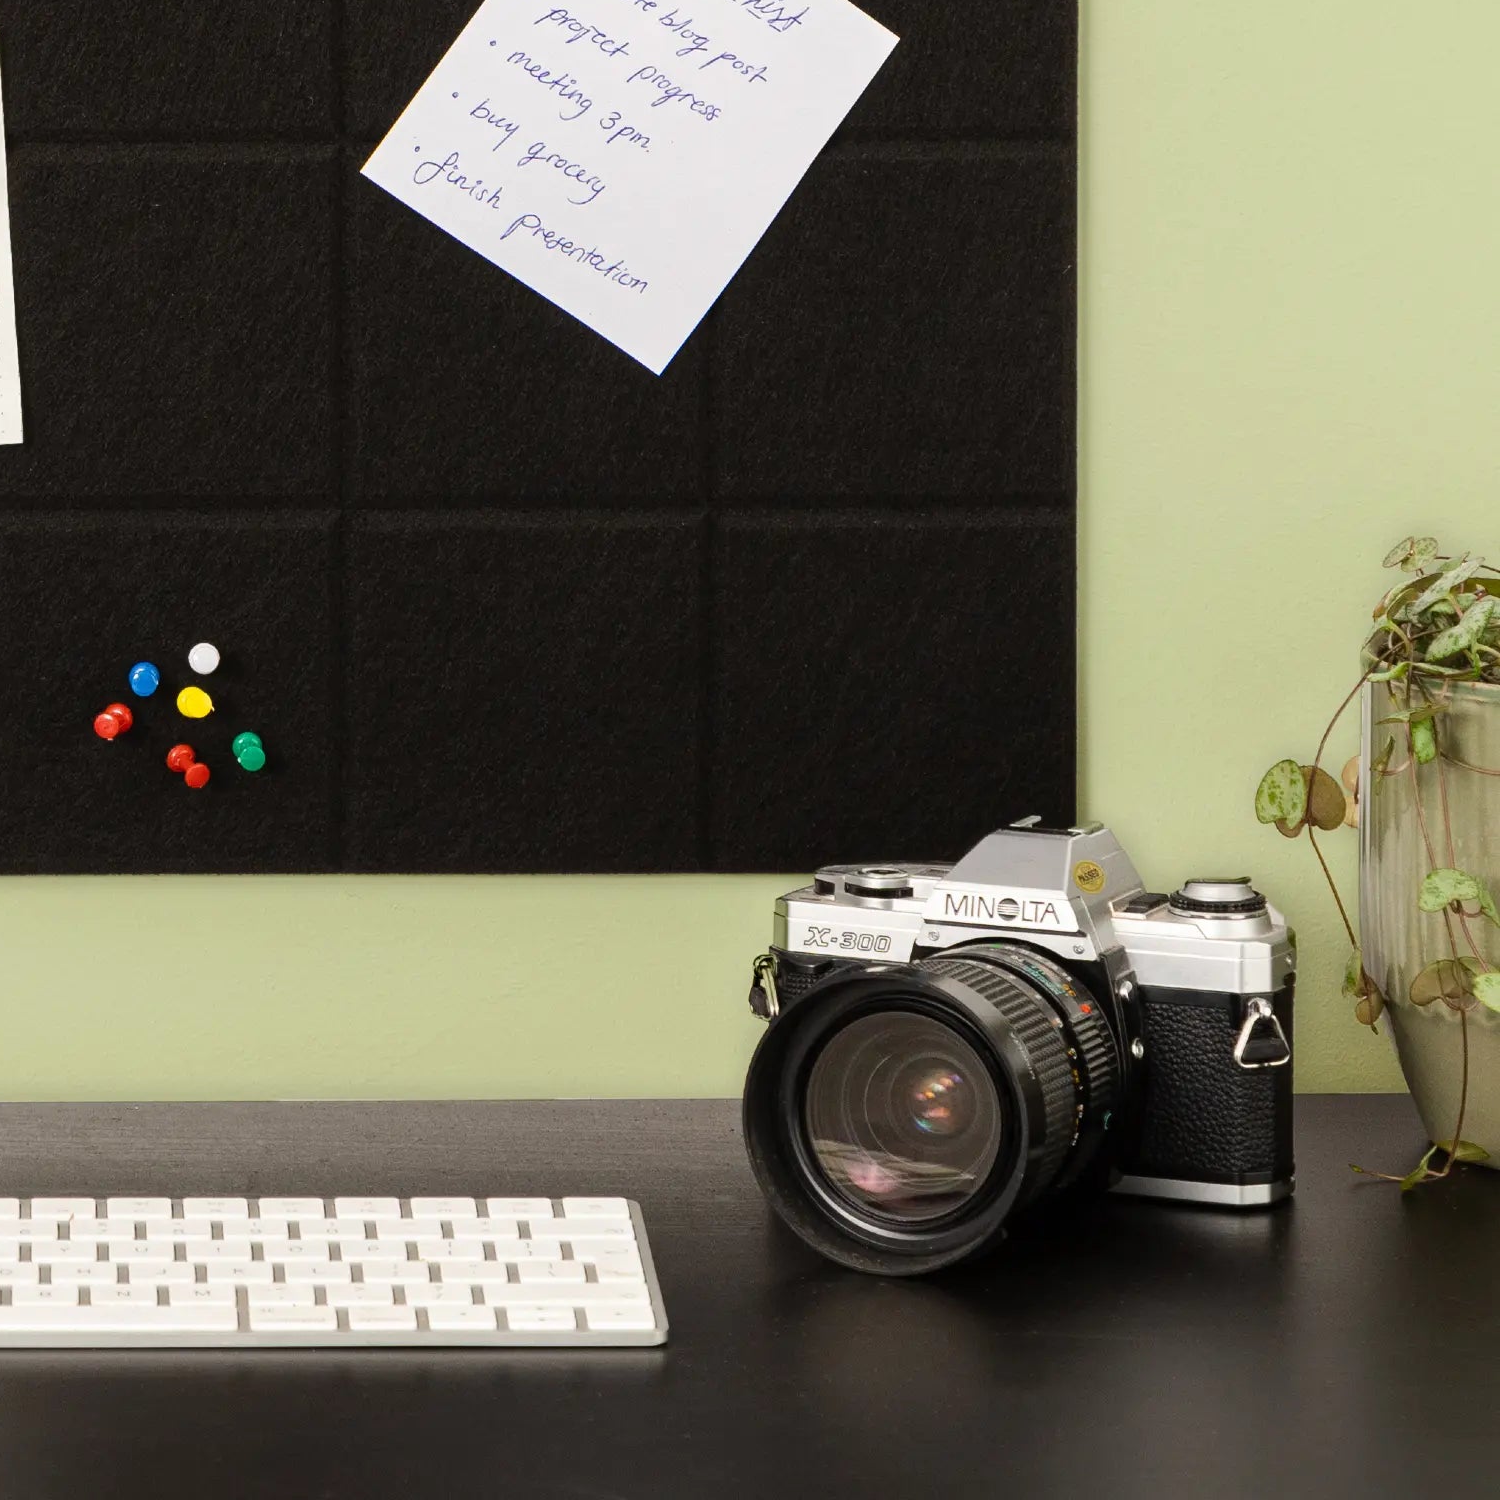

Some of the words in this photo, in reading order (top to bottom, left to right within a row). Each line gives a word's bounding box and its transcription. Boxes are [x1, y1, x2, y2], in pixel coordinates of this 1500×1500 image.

[506, 47, 593, 122] meeting
[533, 8, 630, 57] project
[626, 65, 722, 121] progress
[658, 9, 710, 57] blog
[698, 47, 769, 85] post
[469, 100, 520, 152] buy
[517, 141, 607, 206] grocery
[499, 213, 649, 294] presentation
[803, 926, 892, 953] X-300
[943, 893, 1062, 927] MINOLTA
